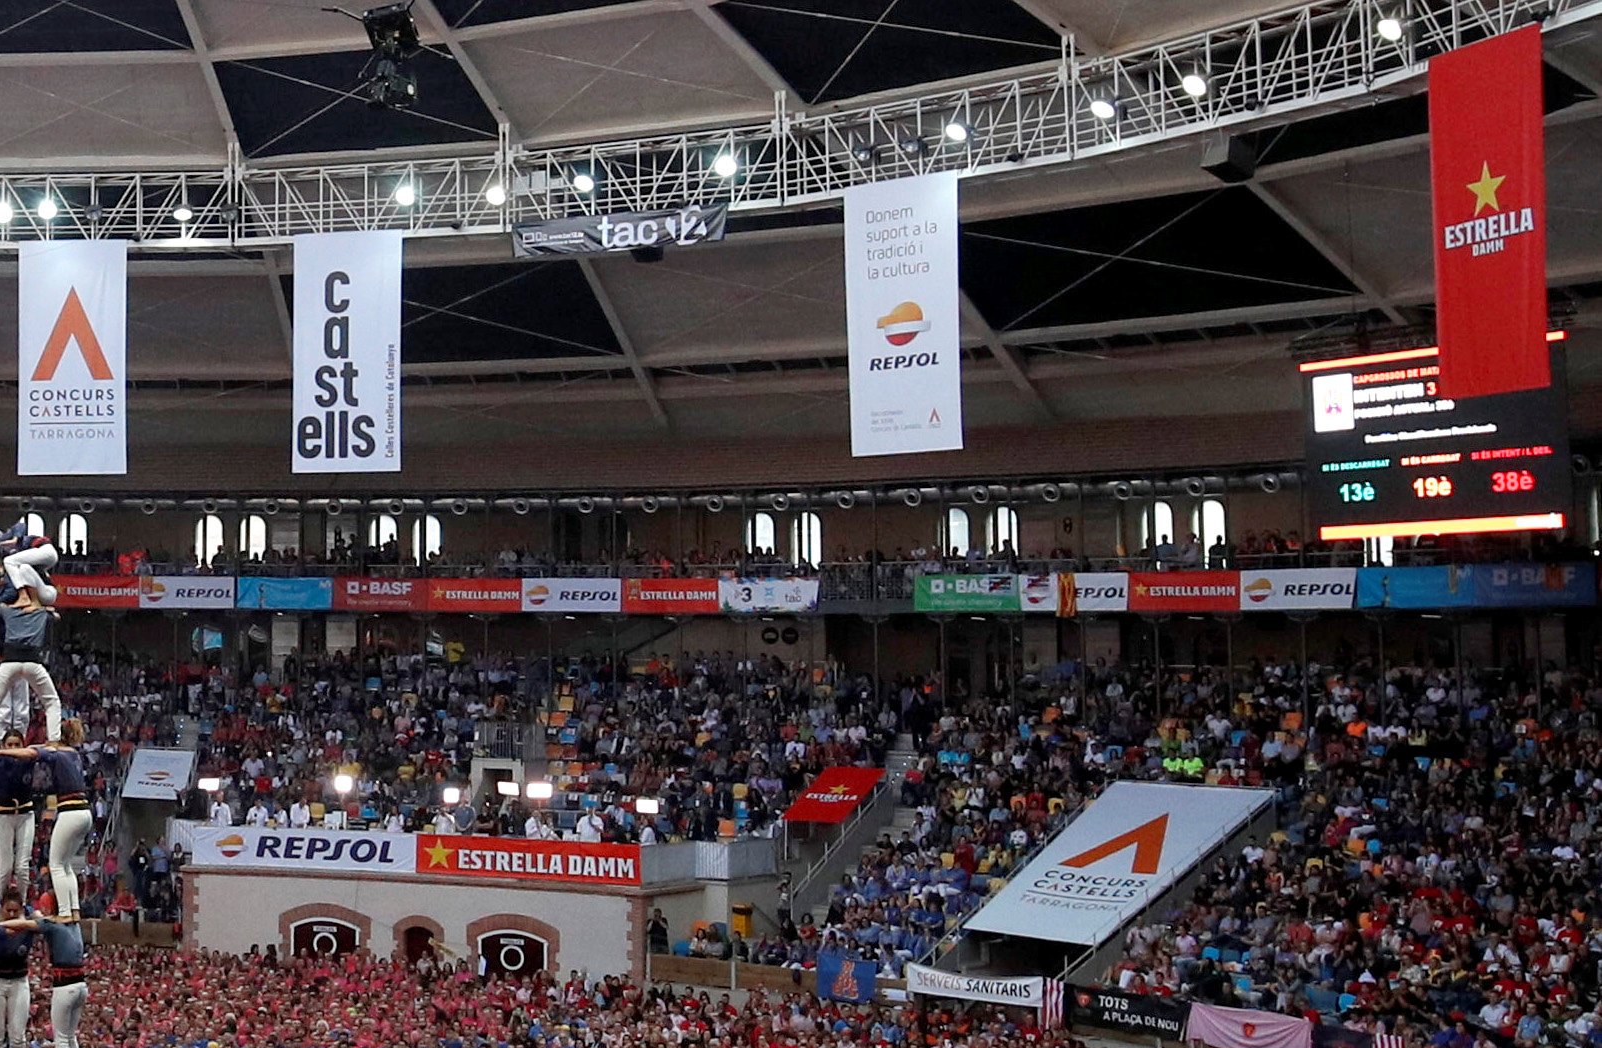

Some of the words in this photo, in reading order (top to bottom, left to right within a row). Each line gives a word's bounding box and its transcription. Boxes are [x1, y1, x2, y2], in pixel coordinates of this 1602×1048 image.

[866, 207, 913, 224] Donem
[866, 226, 908, 243] suport
[913, 224, 921, 235] a
[925, 221, 937, 233] la
[1444, 207, 1534, 249] ESTRELLA
[867, 242, 916, 260] tradició
[1472, 239, 1504, 257] DAMM
[868, 266, 879, 279] la
[883, 261, 930, 277] cultura
[870, 352, 939, 371] REPSOL
[1353, 370, 1406, 384] CAPGROSSOS
[1407, 368, 1418, 378] DE
[30, 389, 114, 401] CONCURS
[1426, 382, 1436, 395] 3
[30, 404, 114, 417] CASTELLS
[30, 428, 114, 439] TARRAGONA
[1413, 476, 1452, 497] 19è
[1491, 471, 1534, 492] 38è
[1339, 482, 1375, 502] 13è
[66, 586, 110, 596] ESTRELLA
[111, 587, 139, 597] DAMM
[175, 588, 232, 599] REPSOL
[369, 581, 412, 595] BASF
[956, 578, 990, 594] BAS
[1075, 586, 1126, 599] EPSOL
[1149, 585, 1200, 596] ESTRELLA
[1201, 585, 1236, 597] DAMM
[1284, 584, 1353, 596] REPSOL
[446, 591, 489, 600] ESTRELLA
[490, 591, 519, 600] DAMM
[559, 590, 618, 601] REPSOL
[640, 590, 684, 600] ESTRELLA
[686, 590, 716, 600] DAMM
[256, 836, 394, 863] REPSOL
[458, 849, 564, 874] ESTRELLA
[568, 855, 635, 879] DAMM
[1045, 870, 1147, 888] CONCURS
[1034, 879, 1138, 898] CASTELLS
[1020, 894, 1119, 912] TARRAGONA
[916, 971, 962, 990] SERVEIS
[965, 979, 1032, 998] SANITARIS
[1099, 995, 1128, 1011] TOTS
[1103, 1011, 1111, 1021] A
[1112, 1012, 1143, 1026] PLAÇA
[1145, 1016, 1157, 1028] DE
[1158, 1018, 1179, 1032] NOU
